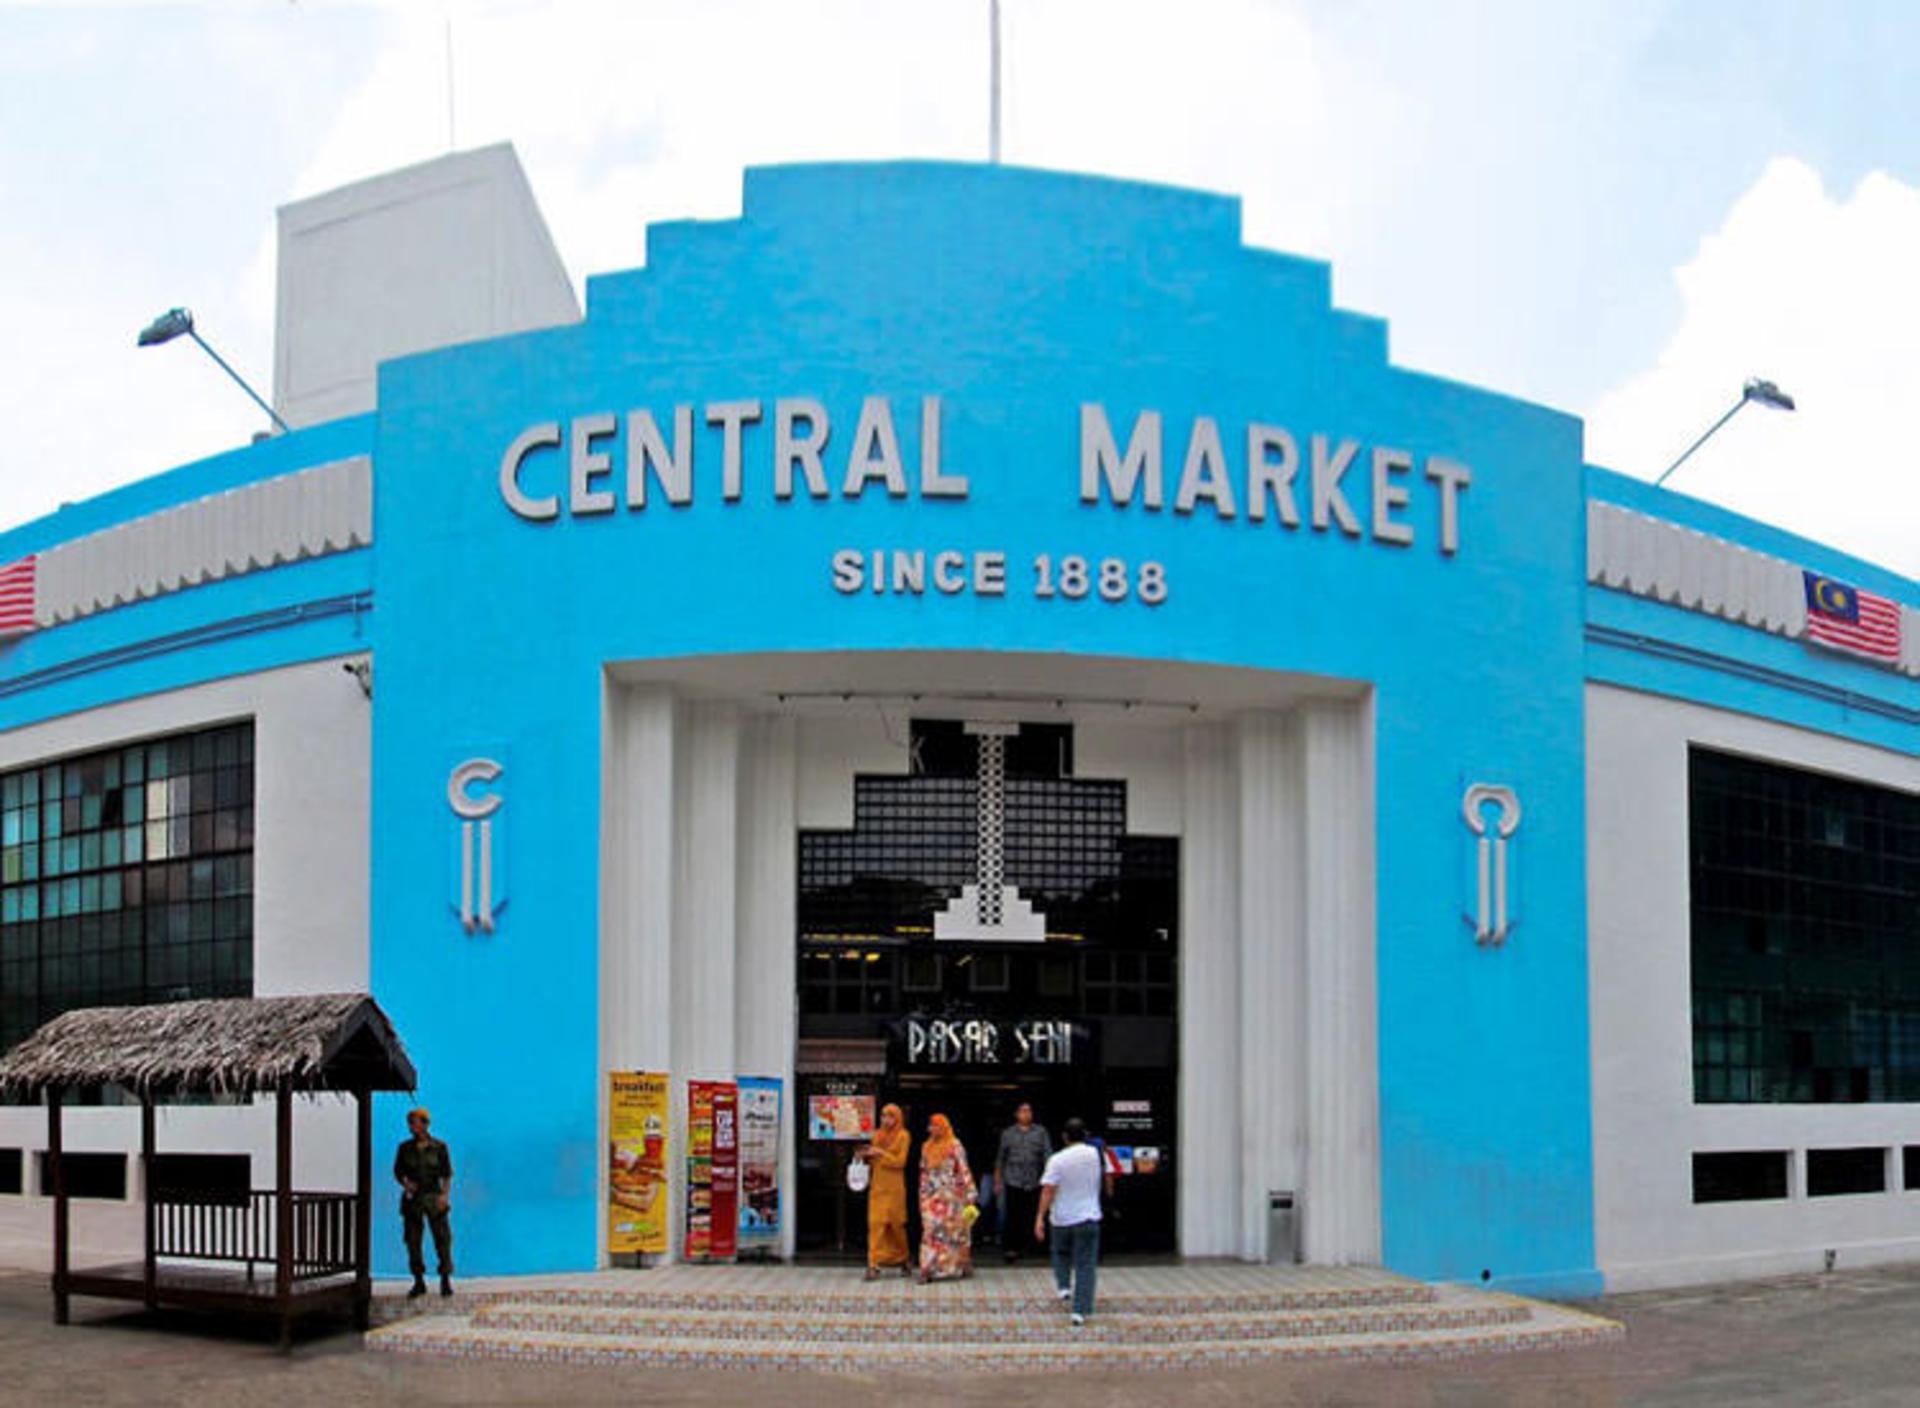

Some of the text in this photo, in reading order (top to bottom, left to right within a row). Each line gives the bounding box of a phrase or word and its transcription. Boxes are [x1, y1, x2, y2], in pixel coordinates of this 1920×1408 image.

[499, 397, 1472, 557] CENTRAL MARKET
[832, 549, 1168, 604] SINCE 1888
[908, 1020, 1072, 1064] PASAR SENI
